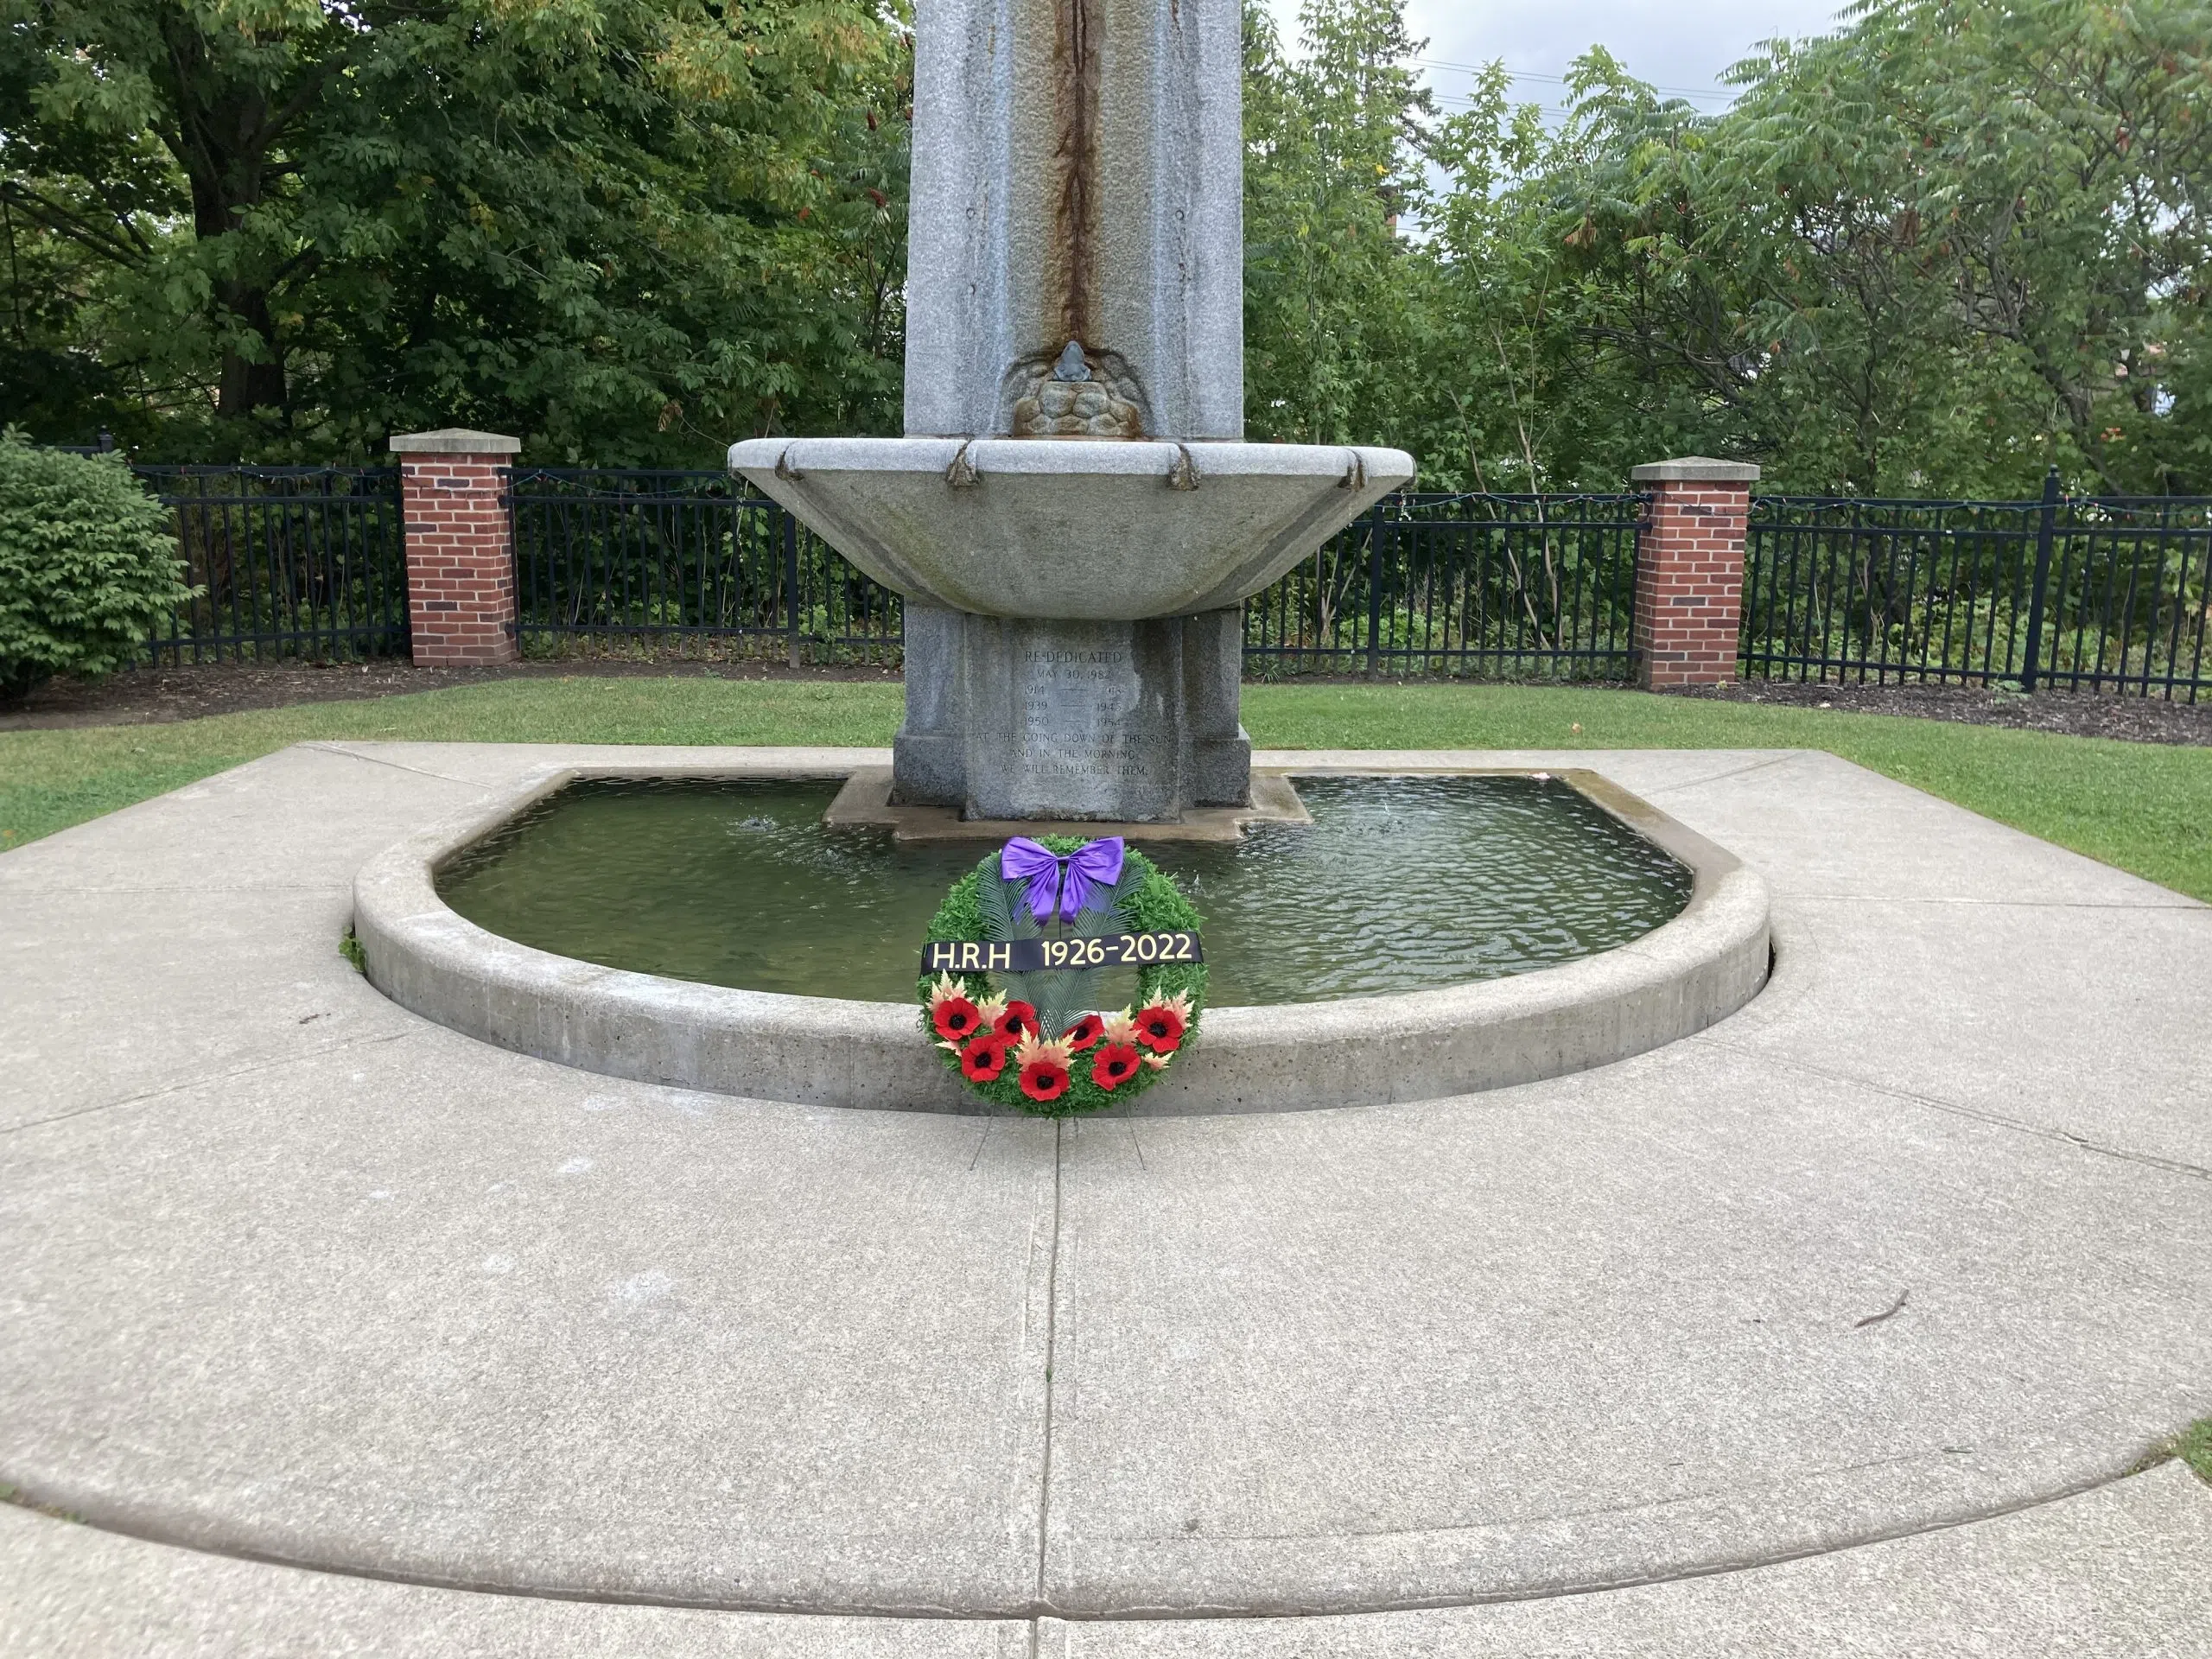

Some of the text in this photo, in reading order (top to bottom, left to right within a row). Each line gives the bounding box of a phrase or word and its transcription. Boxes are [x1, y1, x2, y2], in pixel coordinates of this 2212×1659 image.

[1025, 651, 1122, 664] RE-DEDICATED
[1037, 669, 1111, 680] MAY 30, 1982
[1025, 684, 1045, 695] 1914
[1025, 701, 1048, 710] 1939
[1096, 702, 1122, 711] 1945
[1025, 716, 1049, 726] 1950
[1096, 718, 1121, 728] 1954
[997, 733, 1017, 743] THE
[1023, 734, 1058, 743] GOING
[1064, 734, 1095, 744] DOWN
[1102, 734, 1115, 744] OF
[1123, 734, 1141, 744] THE
[1149, 734, 1172, 744] SUN
[1011, 749, 1135, 760] AND IN THE MORNING
[1001, 764, 1015, 773] WE
[1023, 765, 1047, 773] WILL
[1053, 765, 1109, 774] REMEMBER
[931, 933, 1193, 969] H.R.H 1926-2022
